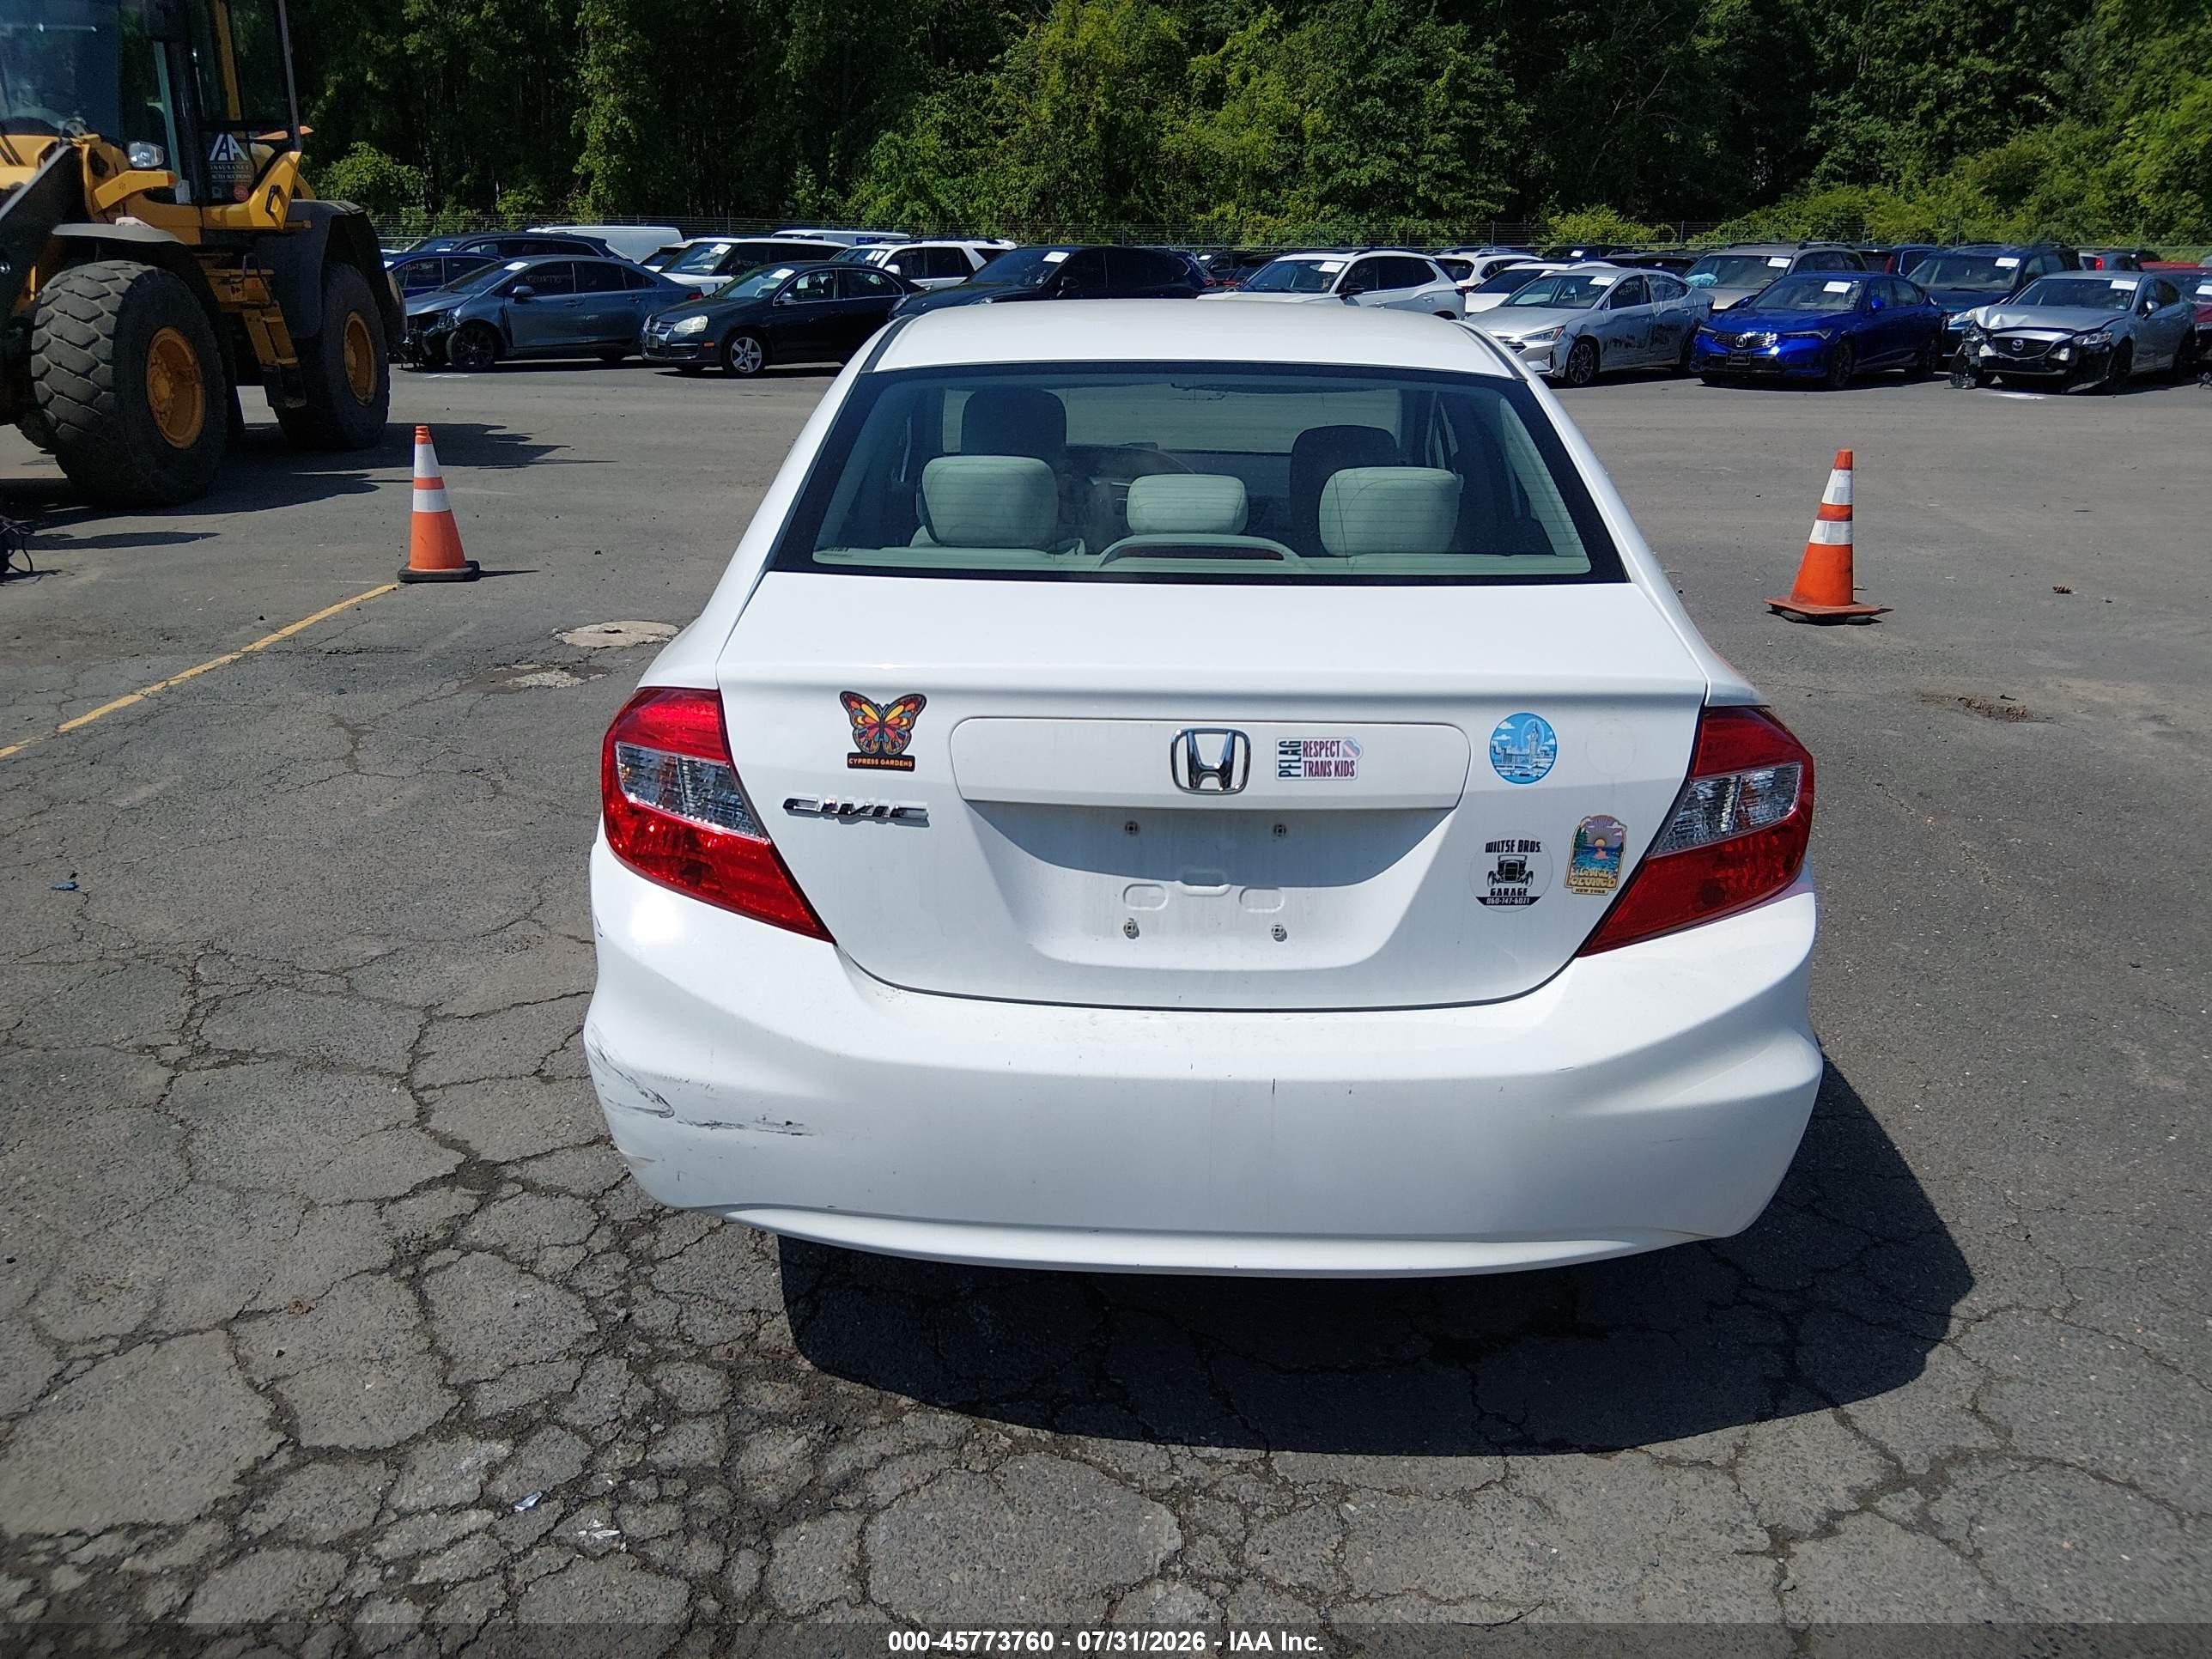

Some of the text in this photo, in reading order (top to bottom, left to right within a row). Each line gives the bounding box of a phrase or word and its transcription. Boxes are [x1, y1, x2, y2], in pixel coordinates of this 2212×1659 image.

[1303, 740, 1341, 757] RESPECT
[1278, 740, 1302, 778] PFLAG
[1303, 760, 1355, 777] TRANS KIDS
[1485, 839, 1516, 854] WILTSE
[1490, 887, 1528, 896] GARAGE
